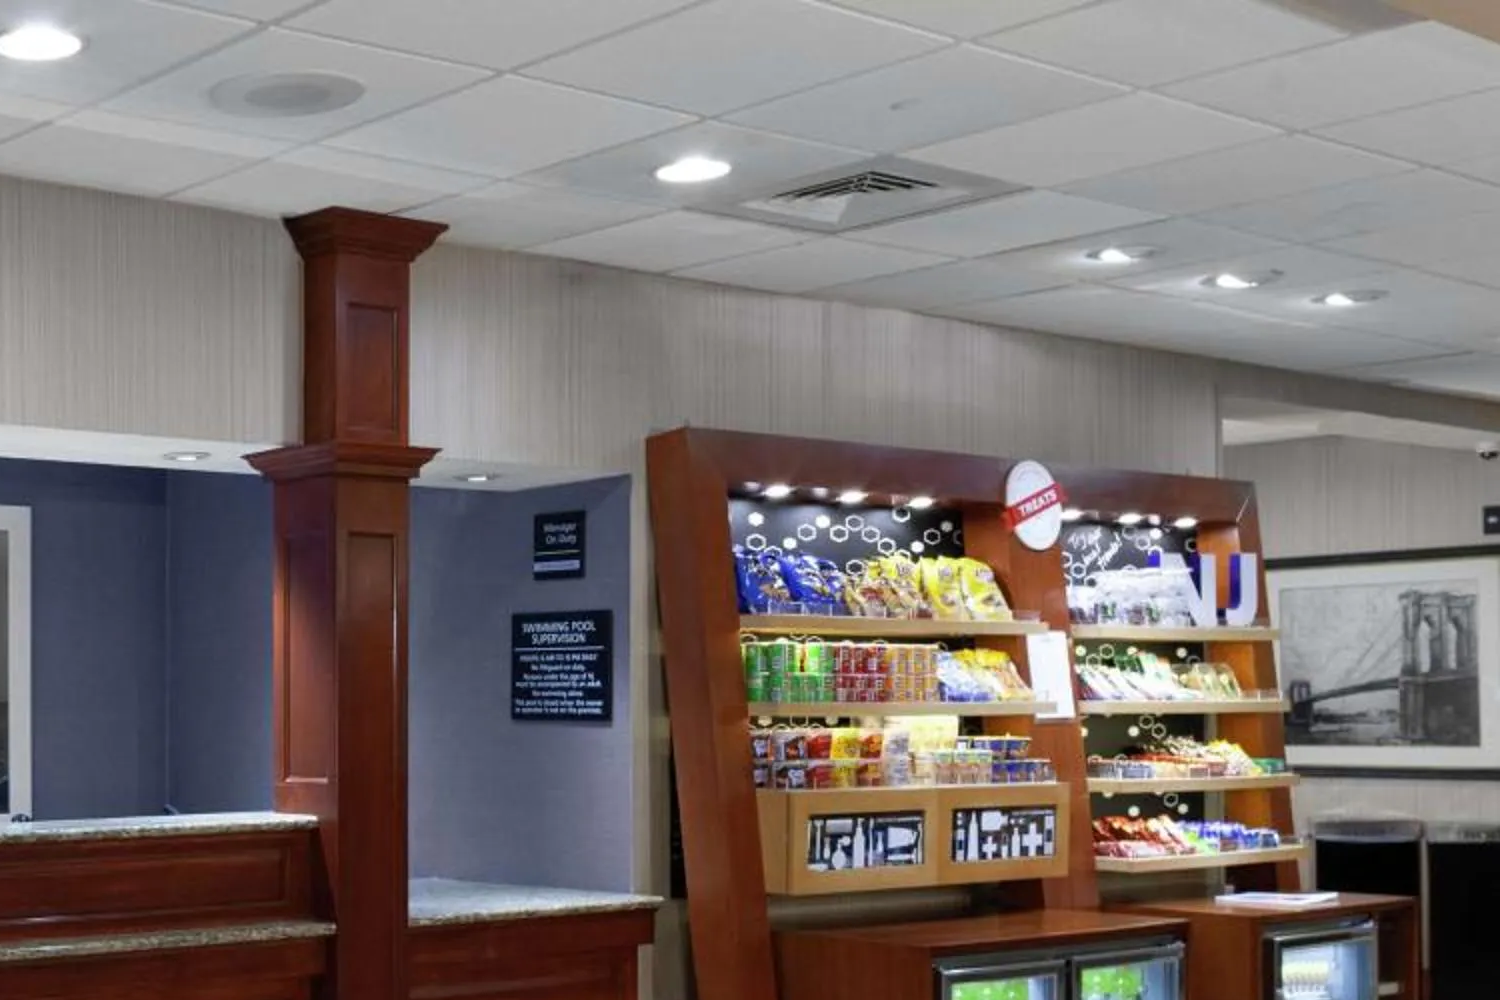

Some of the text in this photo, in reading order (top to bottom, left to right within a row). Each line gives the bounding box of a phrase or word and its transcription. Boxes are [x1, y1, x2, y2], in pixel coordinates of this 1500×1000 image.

[1017, 489, 1057, 516] TREATS
[522, 620, 596, 633] SWIMMING POOL
[531, 632, 586, 645] SUPERVISION
